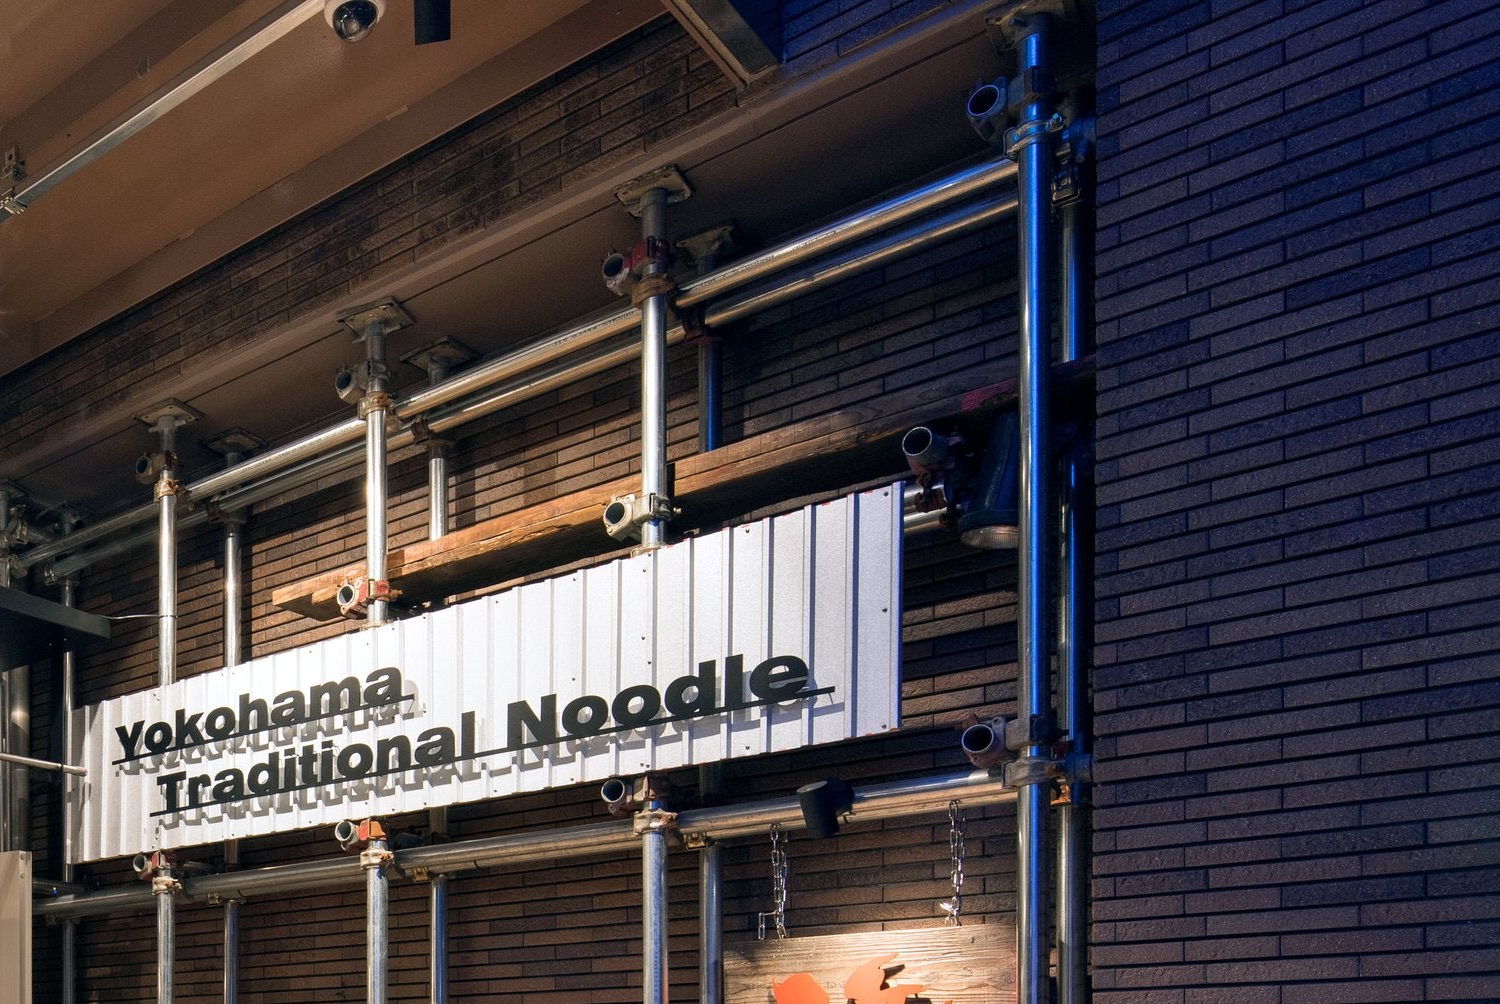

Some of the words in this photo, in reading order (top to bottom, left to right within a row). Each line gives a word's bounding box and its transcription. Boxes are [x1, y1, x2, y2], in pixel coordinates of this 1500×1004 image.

[113, 664, 405, 764] Yokohama
[155, 711, 476, 815] Traditional
[506, 653, 809, 747] Noodle
